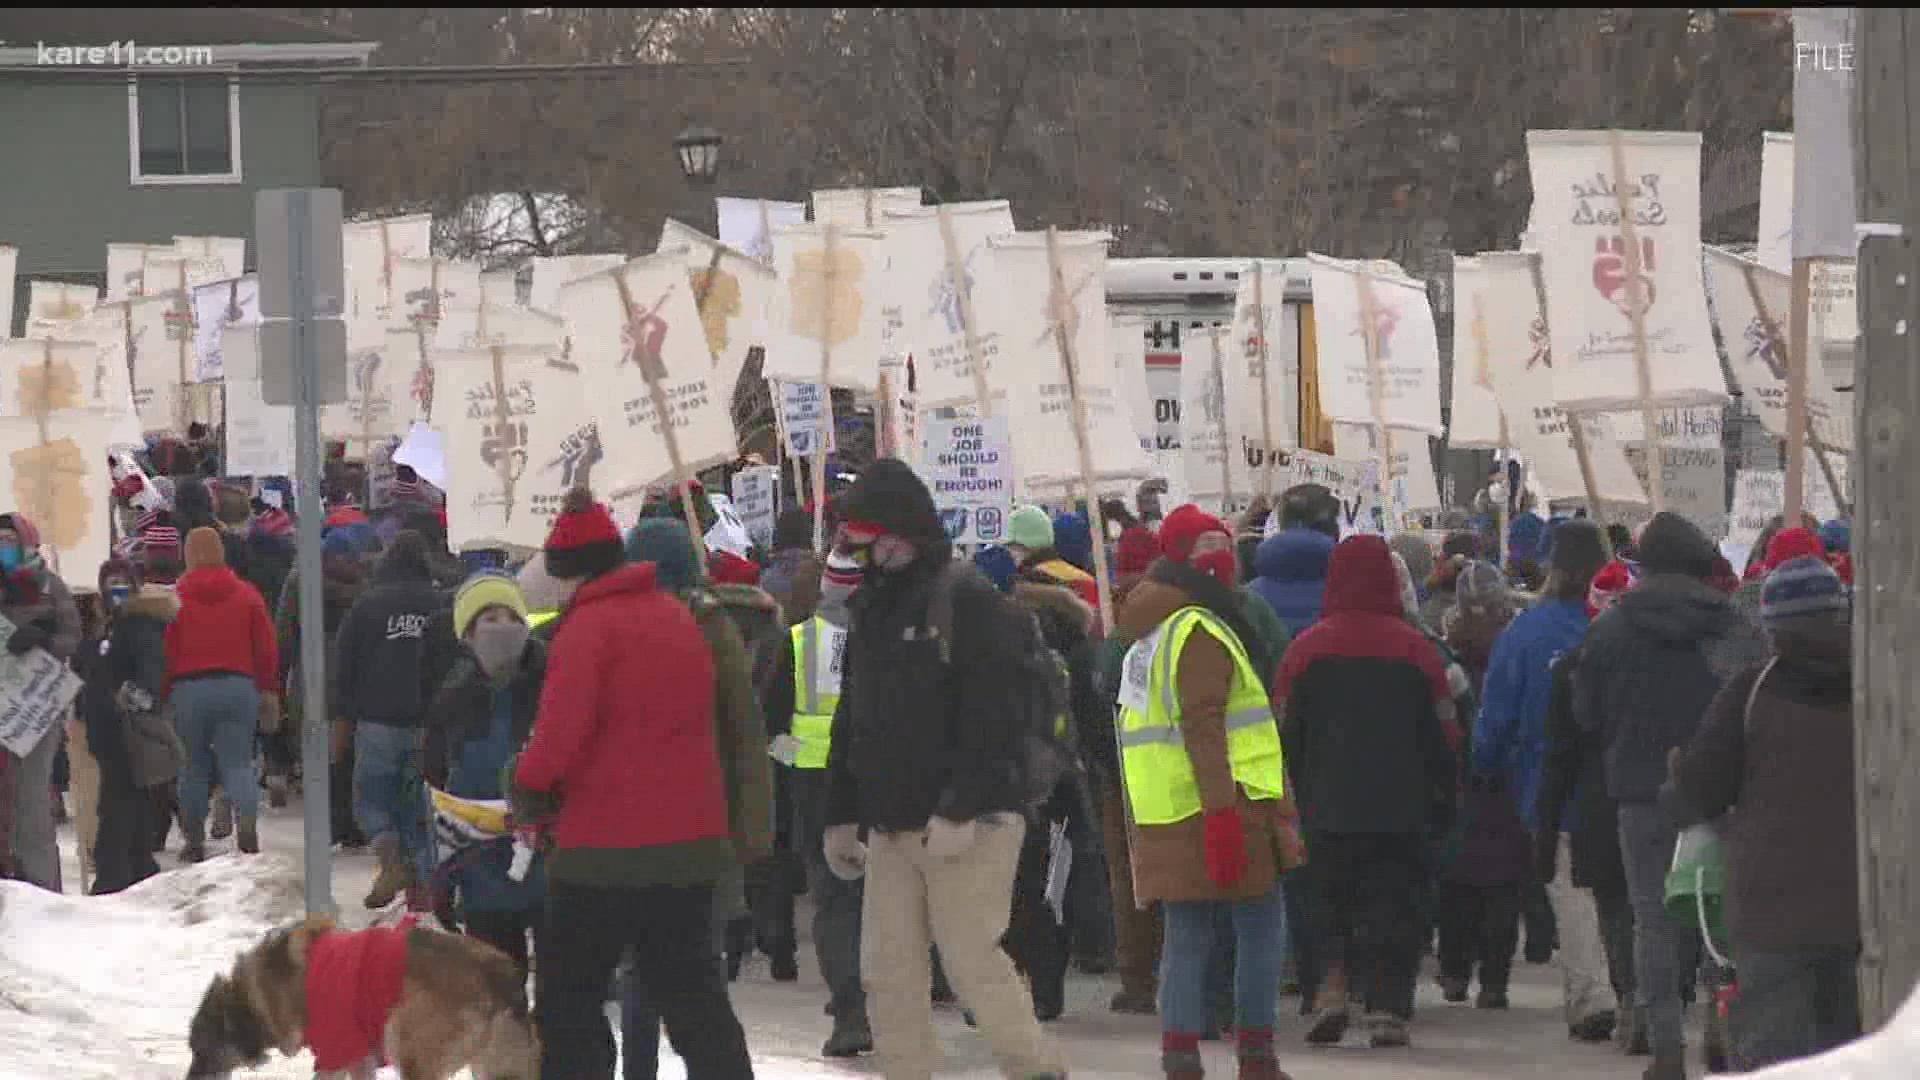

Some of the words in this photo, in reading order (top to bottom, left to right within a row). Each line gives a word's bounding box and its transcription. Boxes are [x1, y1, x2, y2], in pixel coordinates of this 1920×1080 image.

[951, 424, 984, 438] ONE
[955, 439, 983, 452] JOB
[938, 451, 998, 465] SHOULD
[959, 466, 978, 478] BE
[935, 479, 1003, 493] ENOUGH!
